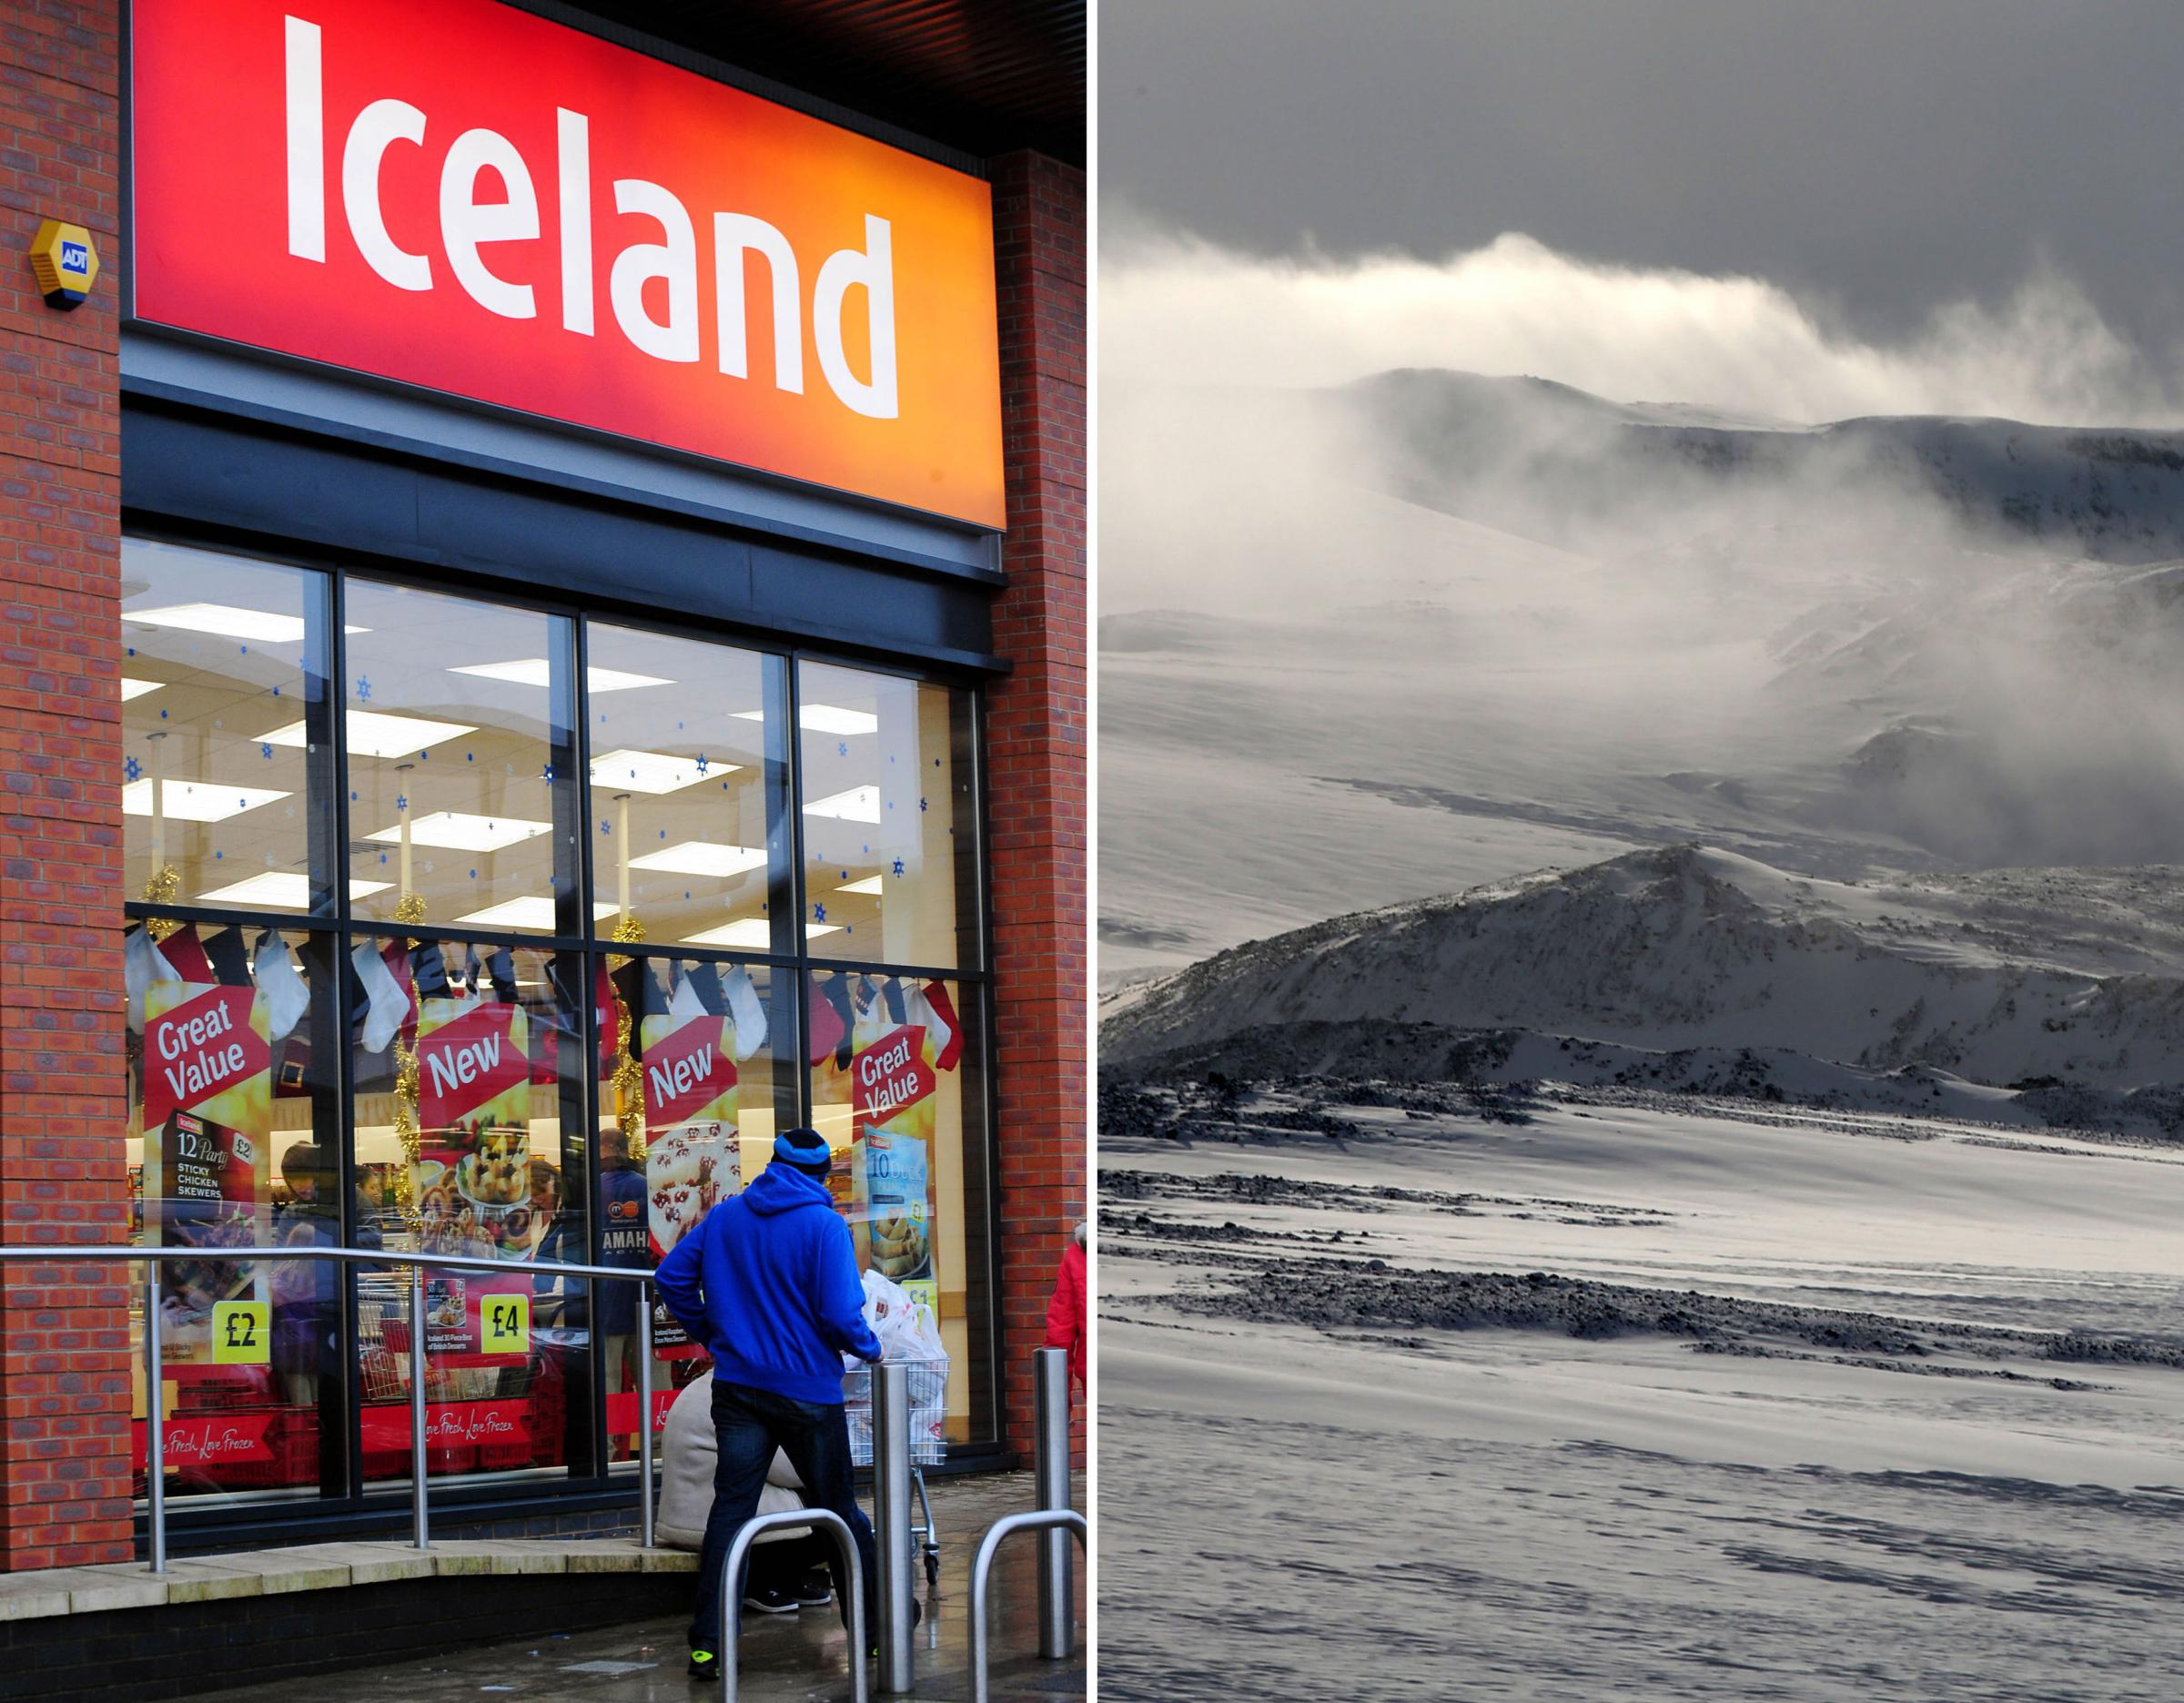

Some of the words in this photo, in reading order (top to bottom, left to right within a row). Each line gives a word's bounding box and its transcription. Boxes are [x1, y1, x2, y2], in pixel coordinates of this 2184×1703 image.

[285, 15, 899, 419] Iceland
[63, 248, 87, 269] ADT
[158, 999, 233, 1060] Great
[164, 1043, 246, 1100] Value
[427, 1031, 500, 1099] New
[649, 1042, 712, 1108] New
[861, 1037, 911, 1087] Great
[864, 1072, 919, 1119] Value
[177, 1132, 197, 1158] 12
[197, 1138, 228, 1171] Party
[236, 1138, 251, 1160] £2
[871, 1153, 890, 1178] 10
[177, 1162, 210, 1176] STICKY
[177, 1174, 218, 1188] CHICKEN
[177, 1186, 221, 1199] SKEWERS
[226, 1313, 256, 1347] £2
[492, 1305, 519, 1337] £4
[440, 1412, 465, 1435] Fresh
[465, 1408, 486, 1440] Love
[168, 1429, 197, 1455] Fresh
[198, 1424, 224, 1459] Love
